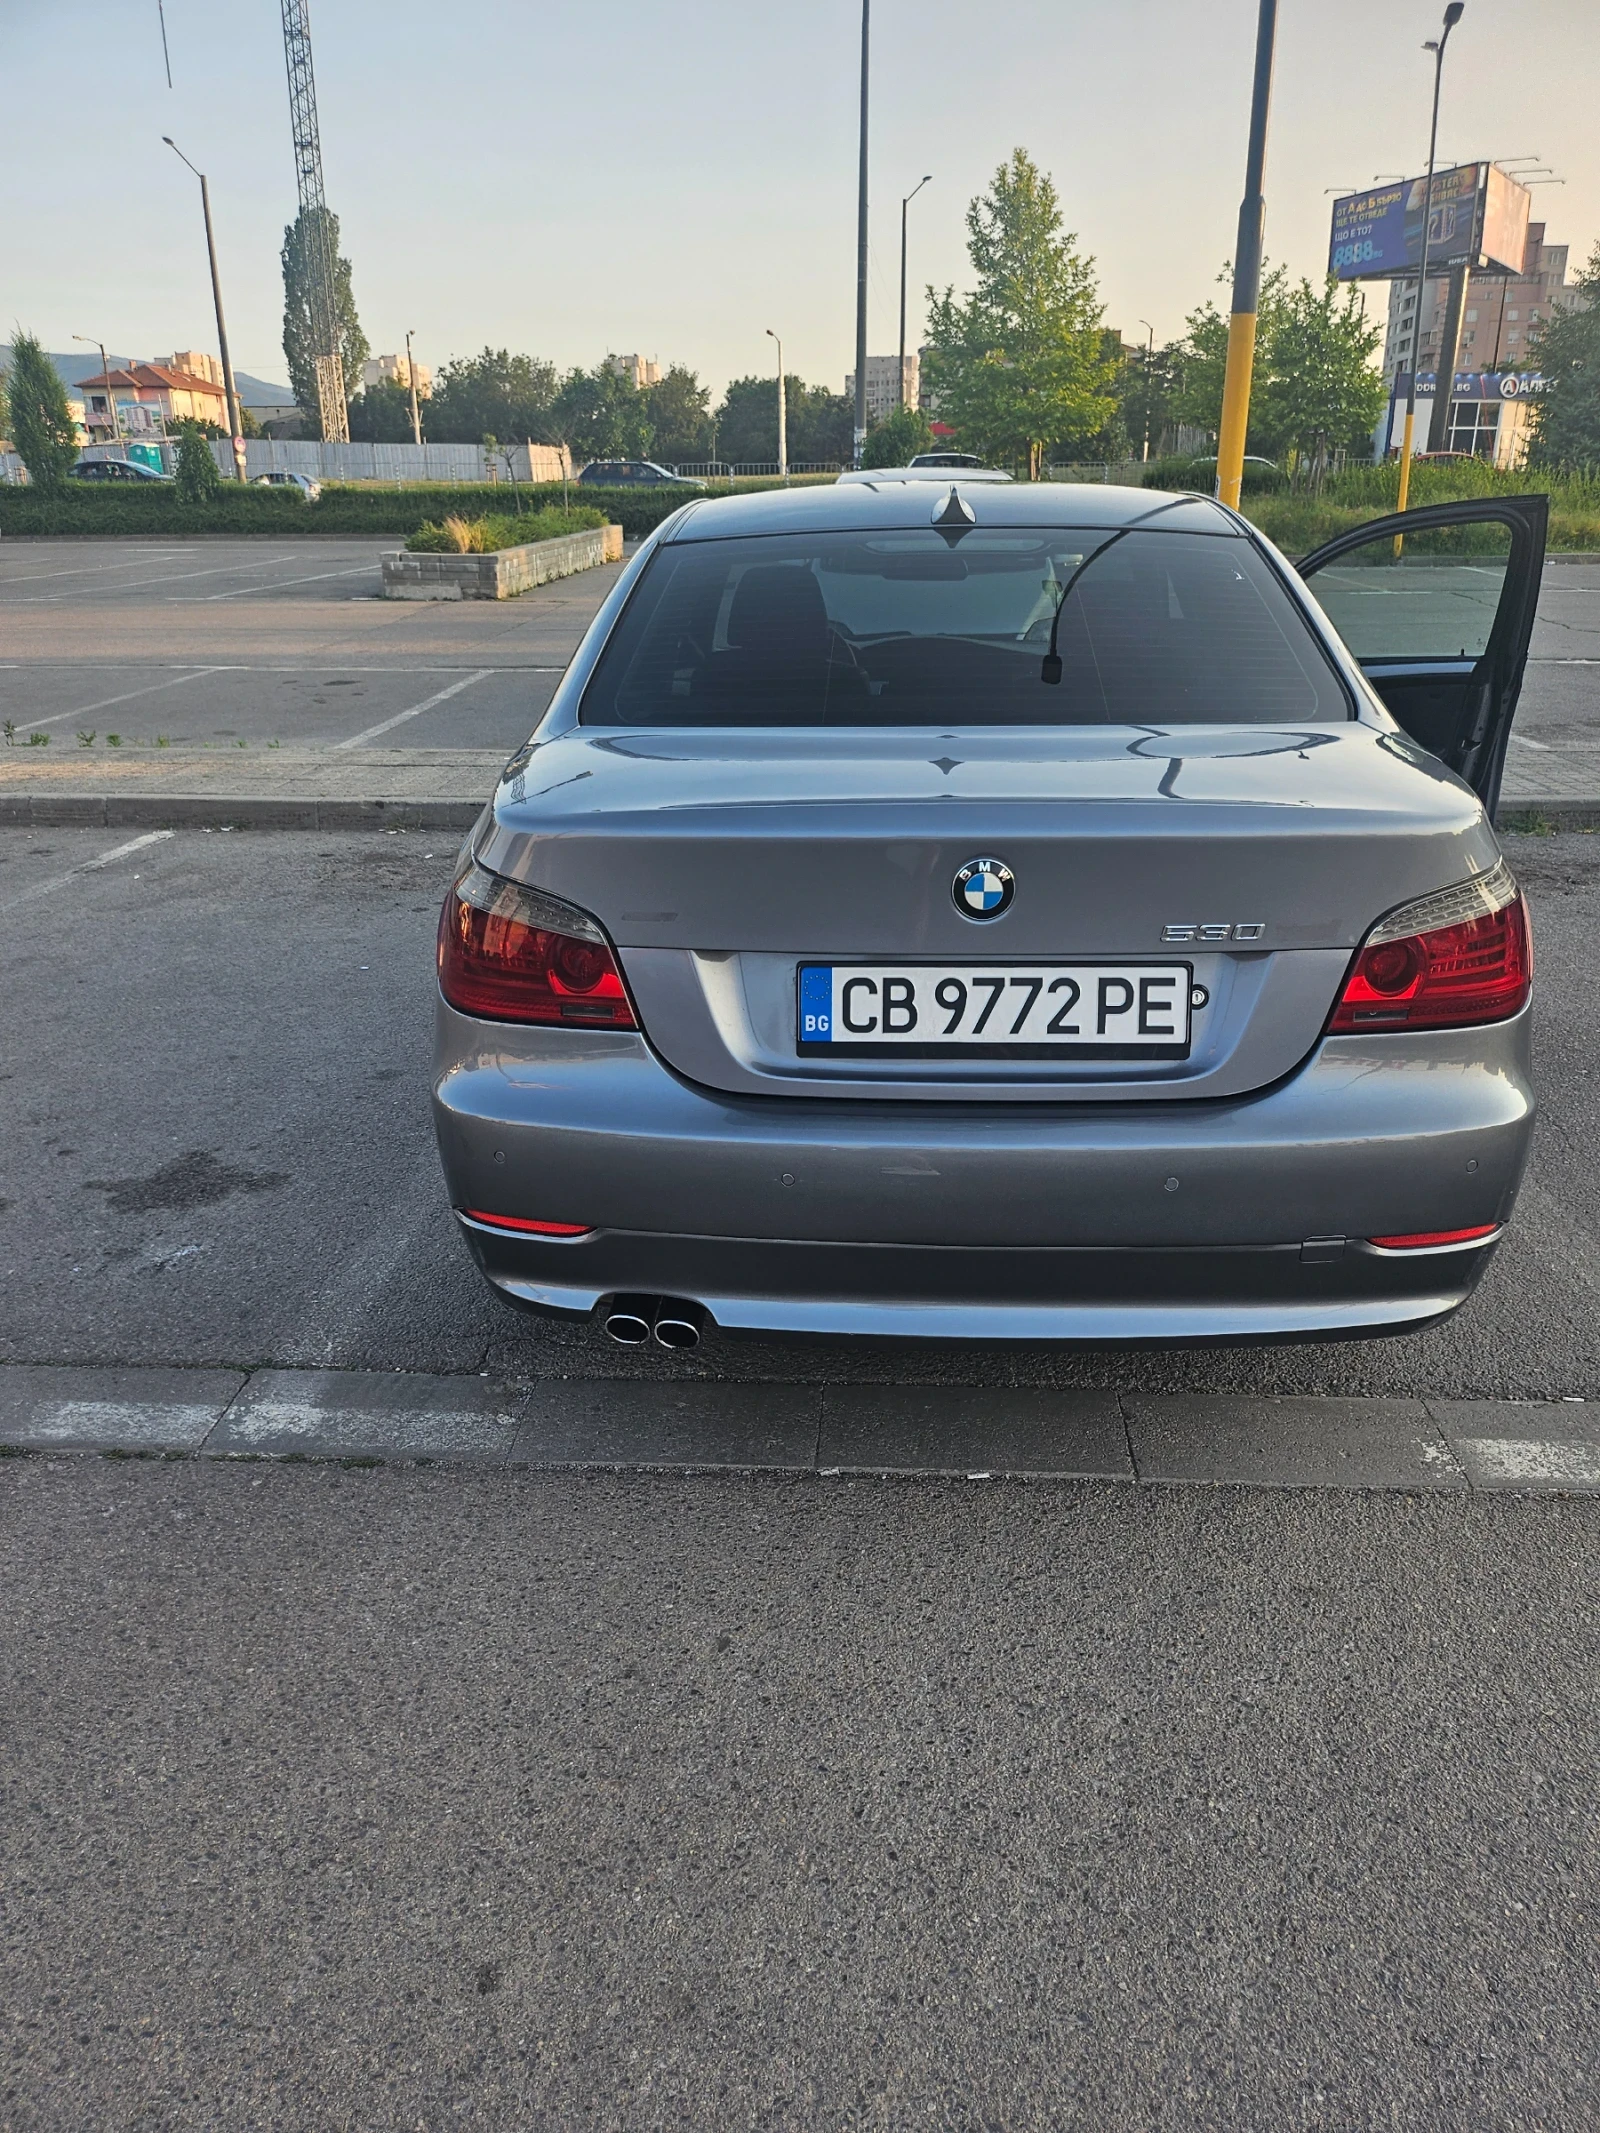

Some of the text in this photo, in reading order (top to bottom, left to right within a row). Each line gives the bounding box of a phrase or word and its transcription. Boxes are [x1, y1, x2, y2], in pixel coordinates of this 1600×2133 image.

[1336, 207, 1347, 217] ОТ
[1347, 202, 1355, 215] А
[1368, 196, 1376, 209] Б
[1336, 207, 1388, 228] ЩЕ ТЕ ОТВЕДЕ
[1335, 224, 1372, 243] ЩО Е ТО?
[959, 862, 1011, 882] BMW
[1160, 923, 1265, 942] 530
[842, 977, 1176, 1034] CB 9772 PE
[805, 1015, 829, 1032] BG
